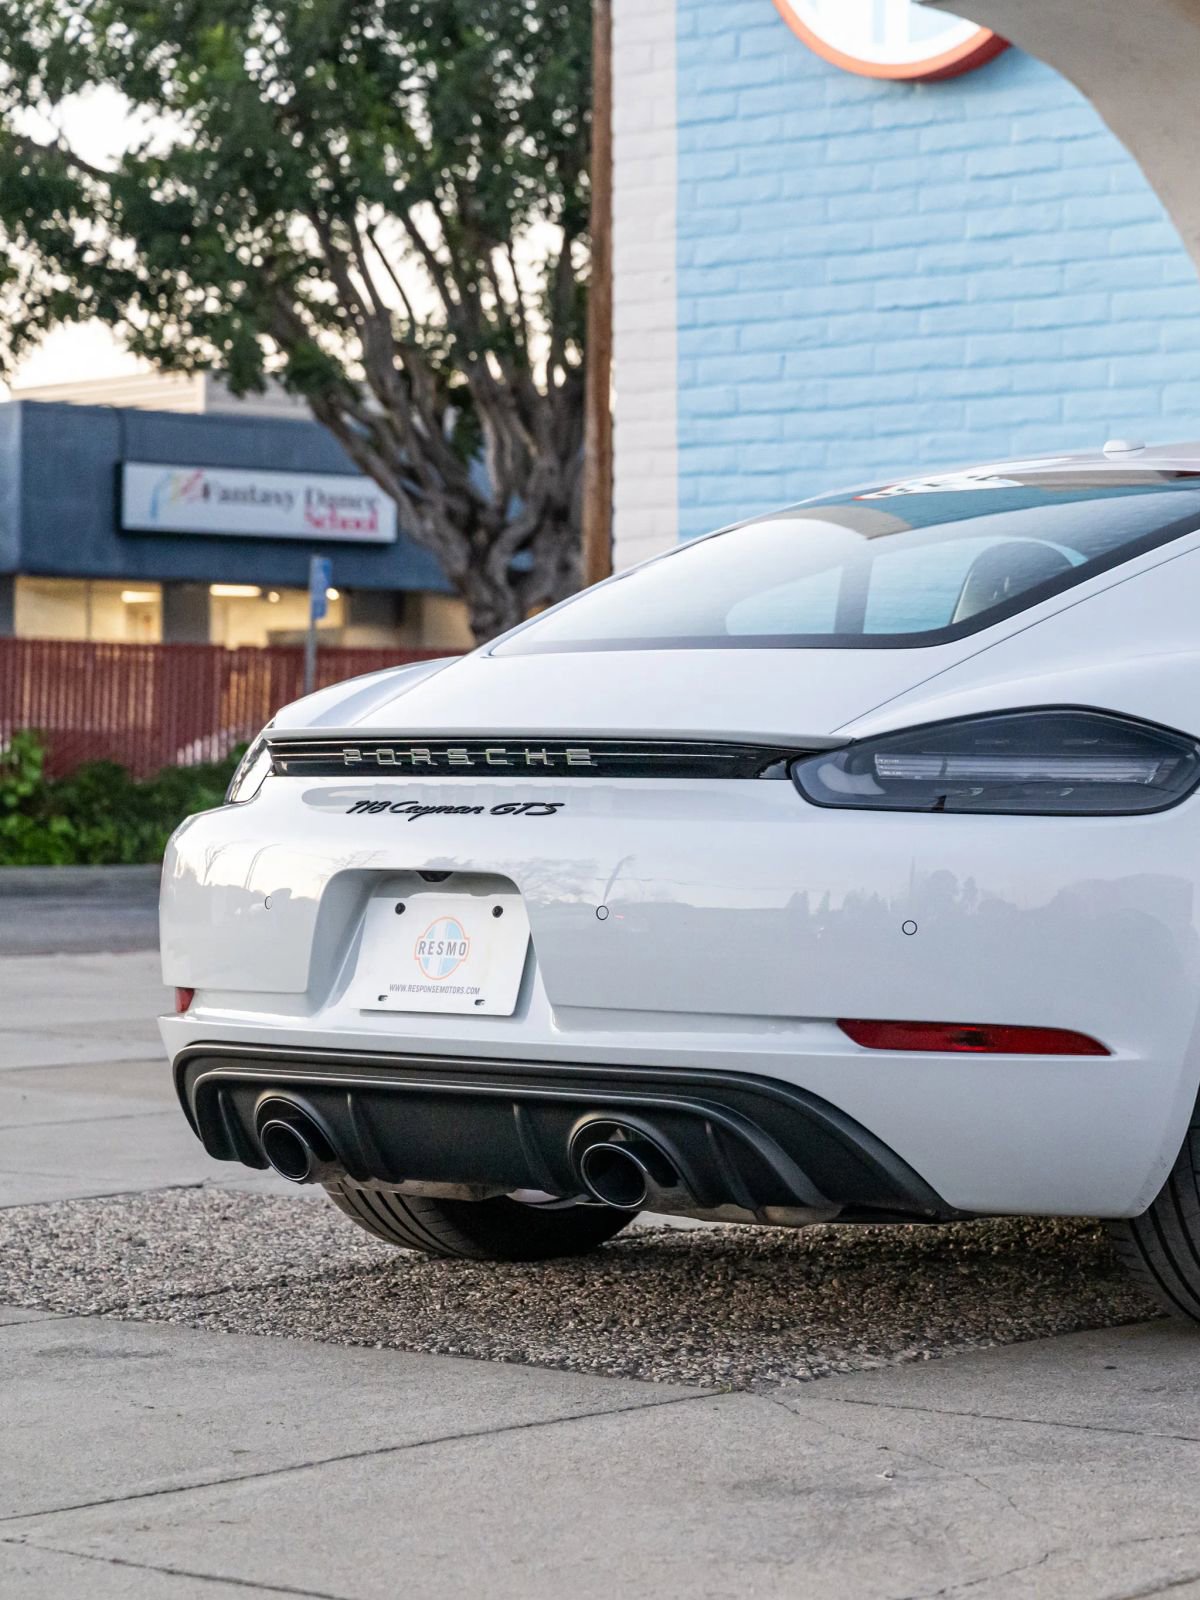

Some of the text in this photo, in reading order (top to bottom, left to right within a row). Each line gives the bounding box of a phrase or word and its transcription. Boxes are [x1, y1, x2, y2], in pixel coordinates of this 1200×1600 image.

[342, 748, 598, 766] PORSCHE
[345, 799, 565, 822] 718 Cayman GTS
[417, 940, 467, 956] RESMO
[389, 983, 481, 996] WWW.RESPONSEMOTORS.COM
